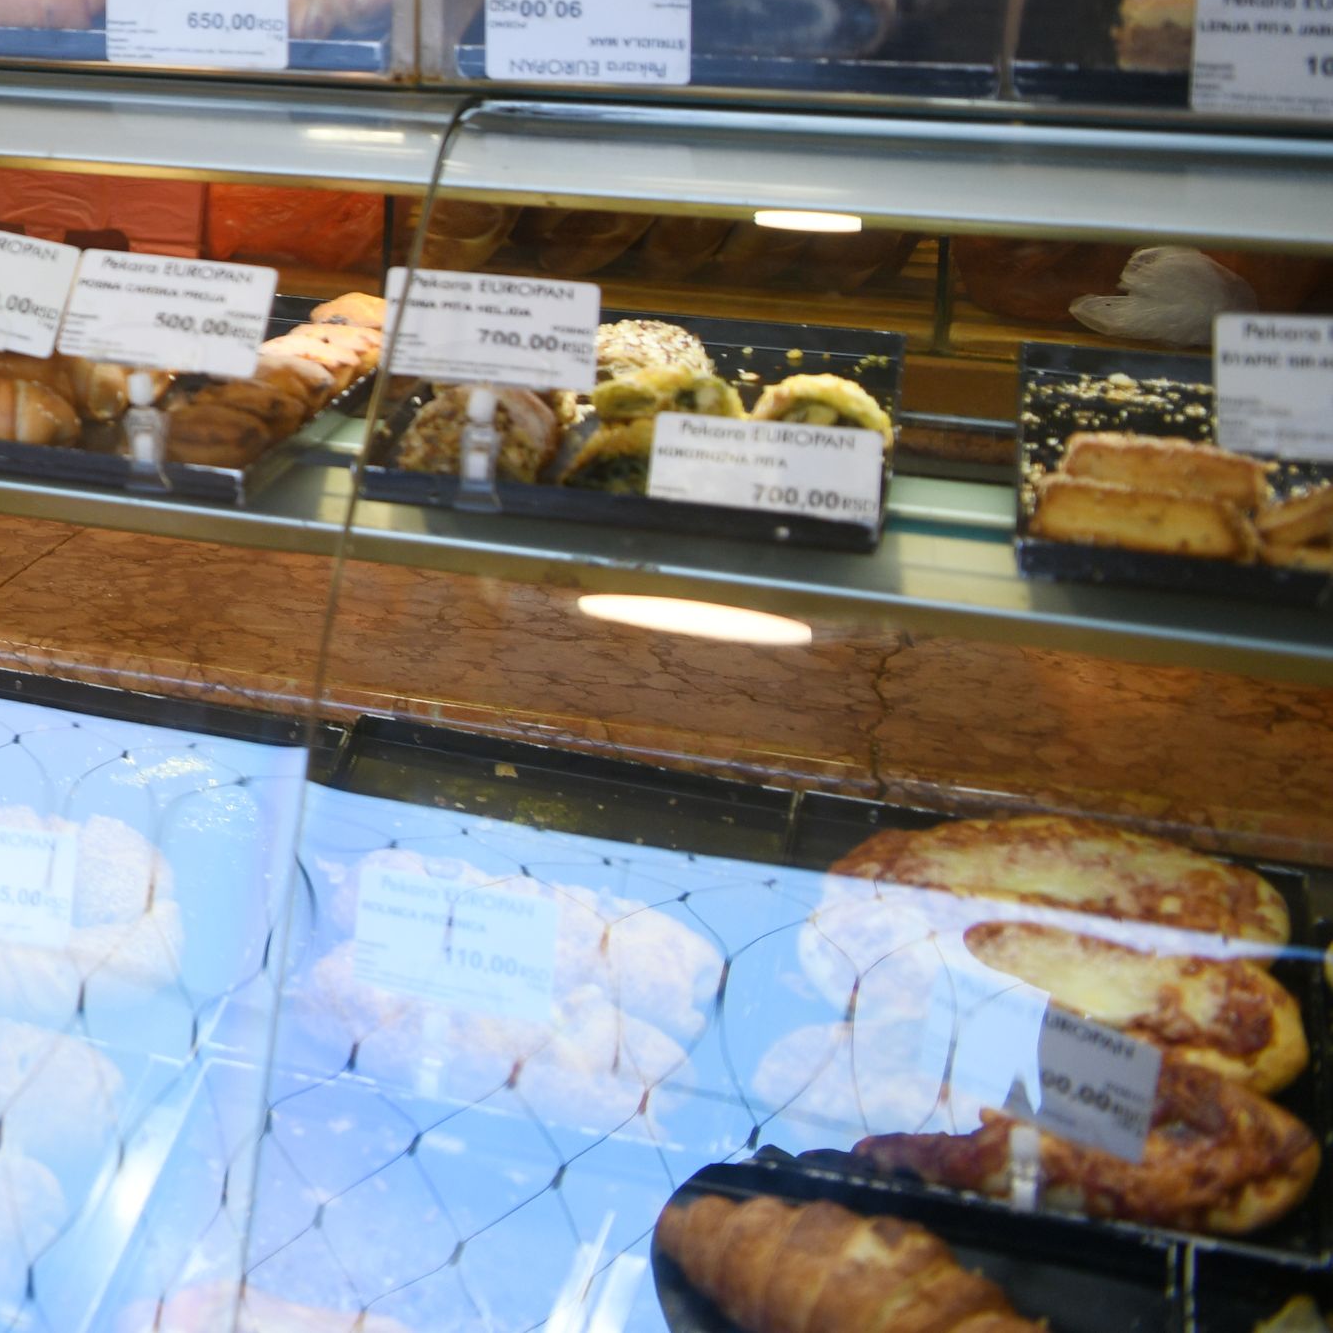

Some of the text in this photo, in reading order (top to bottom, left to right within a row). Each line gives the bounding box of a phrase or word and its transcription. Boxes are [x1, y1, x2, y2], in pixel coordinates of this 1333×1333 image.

[510, 59, 666, 77] Pekara EUROPAN
[102, 256, 254, 283] Pekara EUROPAN
[479, 279, 574, 299] EUROPAN
[680, 420, 855, 449] Pekara EUROPAN
